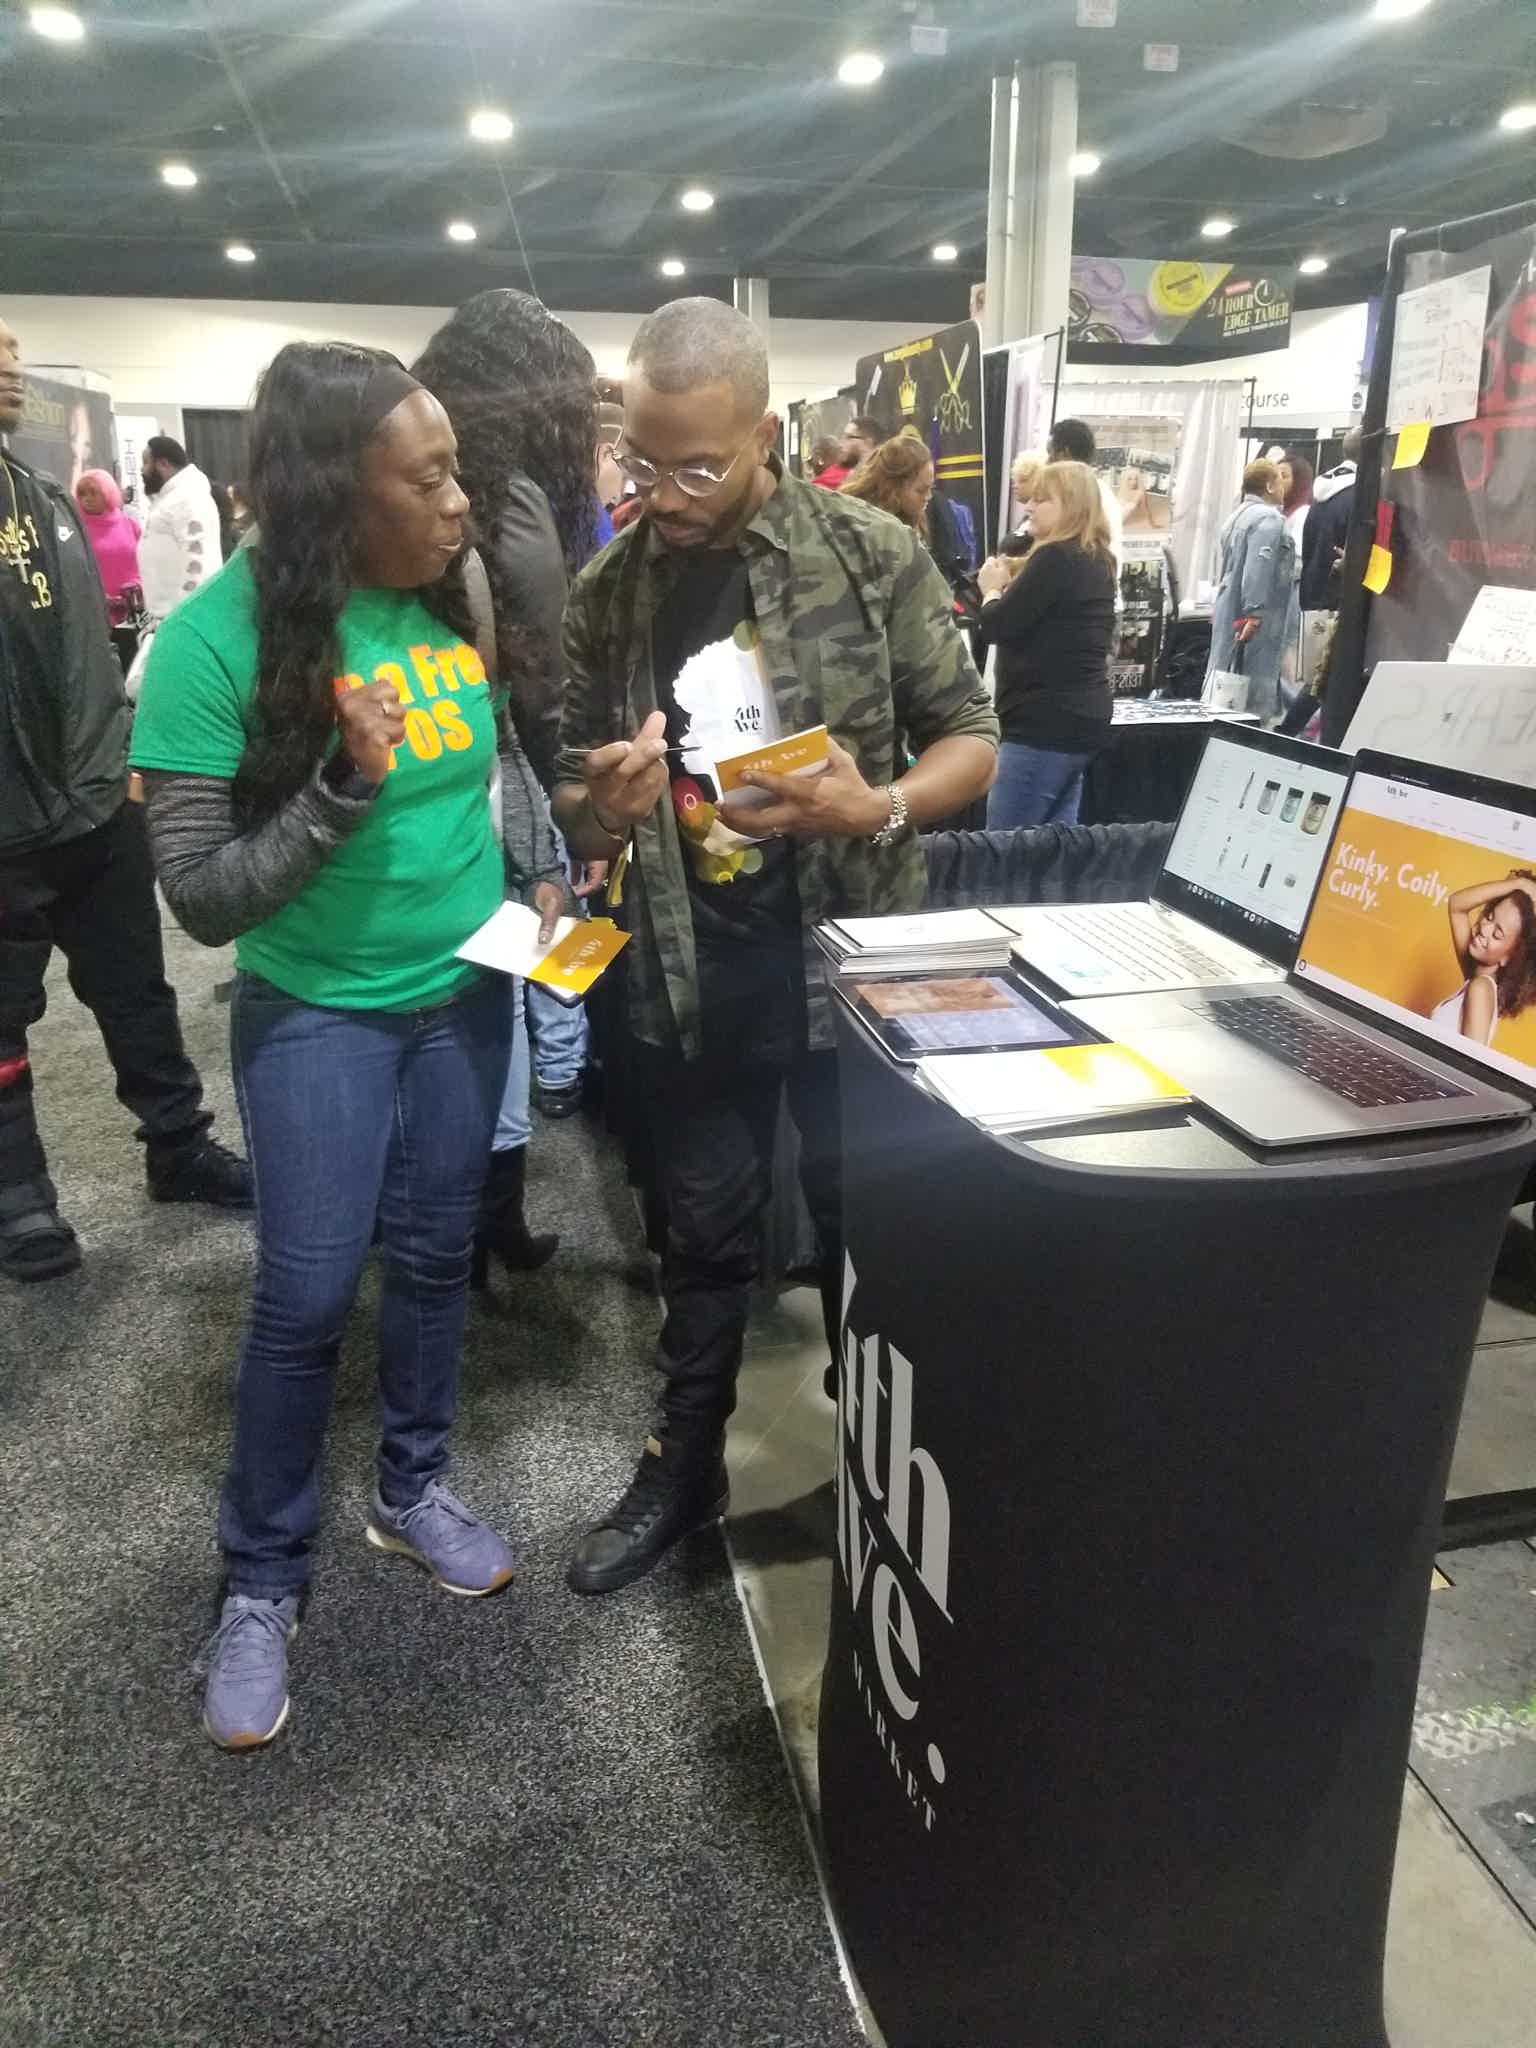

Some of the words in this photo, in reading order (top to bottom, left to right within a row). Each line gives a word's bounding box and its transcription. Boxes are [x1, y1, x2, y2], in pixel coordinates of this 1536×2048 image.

[1224, 310, 1251, 330] EDGE
[1255, 302, 1290, 324] TAMER
[1328, 869, 1378, 911] Curly.
[1335, 842, 1390, 882] Kinky.
[1396, 863, 1450, 907] Coily.
